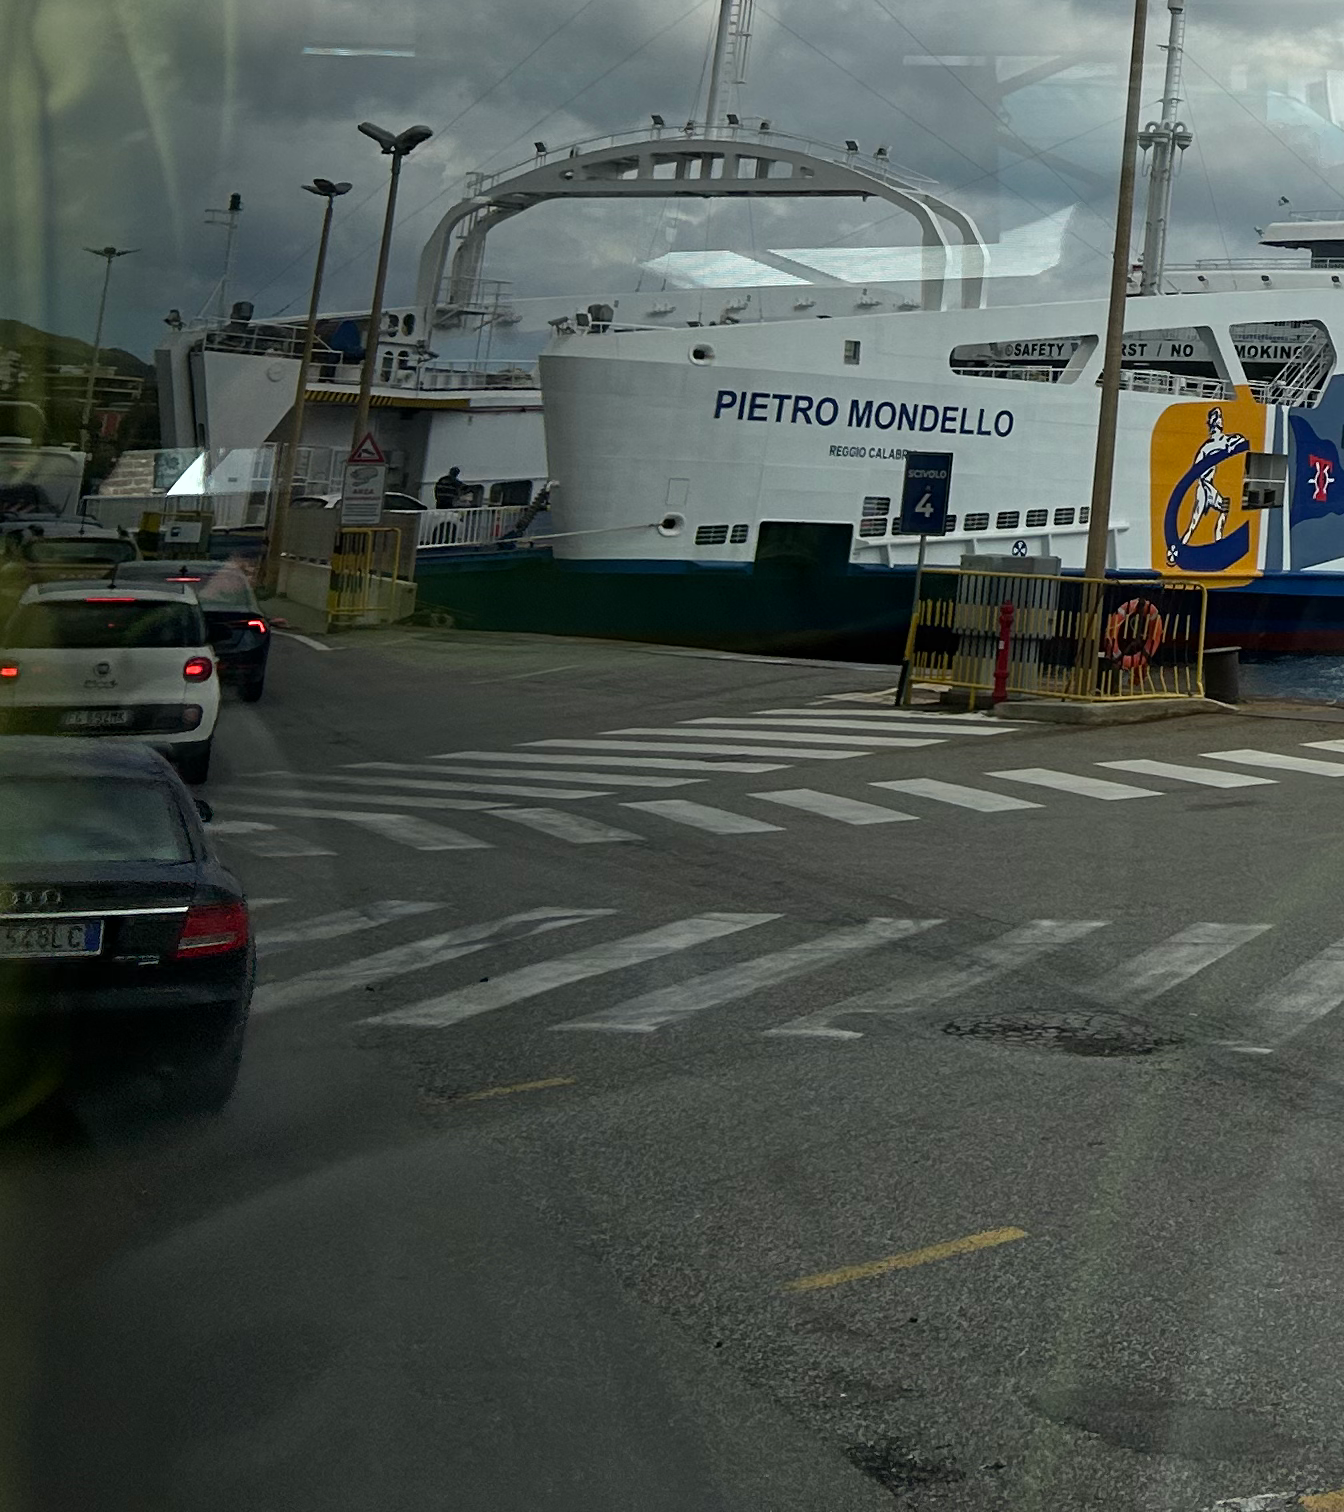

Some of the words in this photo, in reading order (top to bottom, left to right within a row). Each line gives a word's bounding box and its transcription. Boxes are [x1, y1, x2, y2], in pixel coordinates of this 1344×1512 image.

[1014, 342, 1065, 357] SAFETY
[1170, 343, 1194, 357] NO
[1234, 345, 1303, 359] MOKING
[713, 390, 839, 427] PIETRO
[847, 399, 1015, 438] MONDELLO
[829, 445, 866, 458] REGGIO
[868, 447, 914, 460] CALABR
[907, 469, 947, 479] SCIVOLO
[914, 493, 935, 518] 4
